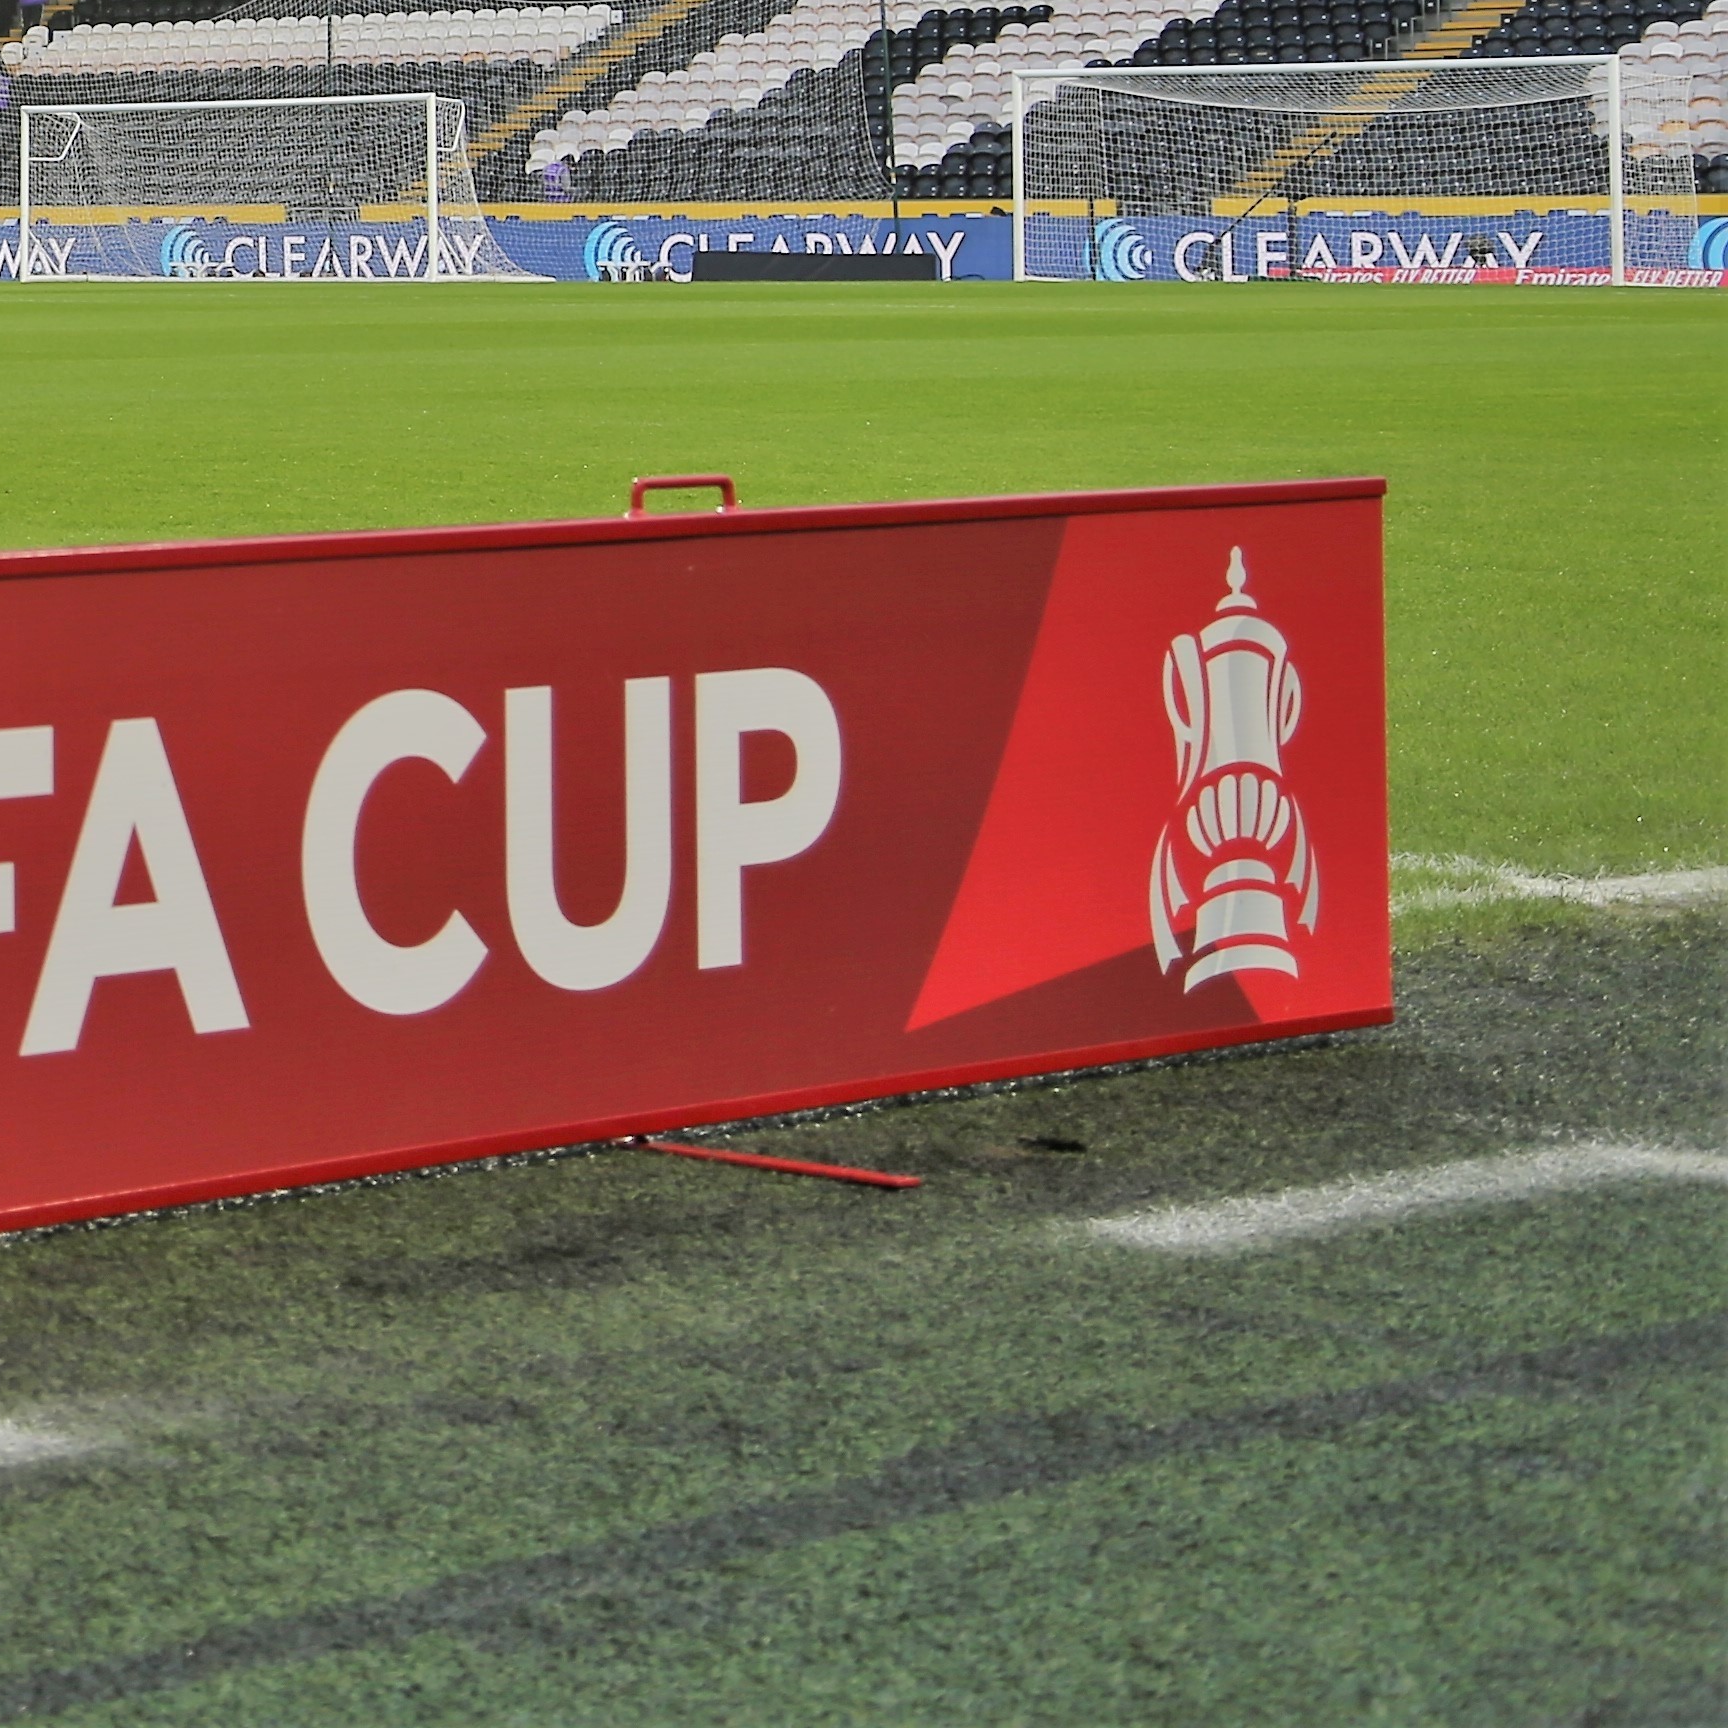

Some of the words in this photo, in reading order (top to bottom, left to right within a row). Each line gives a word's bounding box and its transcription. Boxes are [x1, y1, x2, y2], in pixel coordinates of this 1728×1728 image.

[224, 234, 486, 278] CLEARWAY
[1515, 268, 1612, 286] Emirate
[301, 667, 842, 1016] CUP
